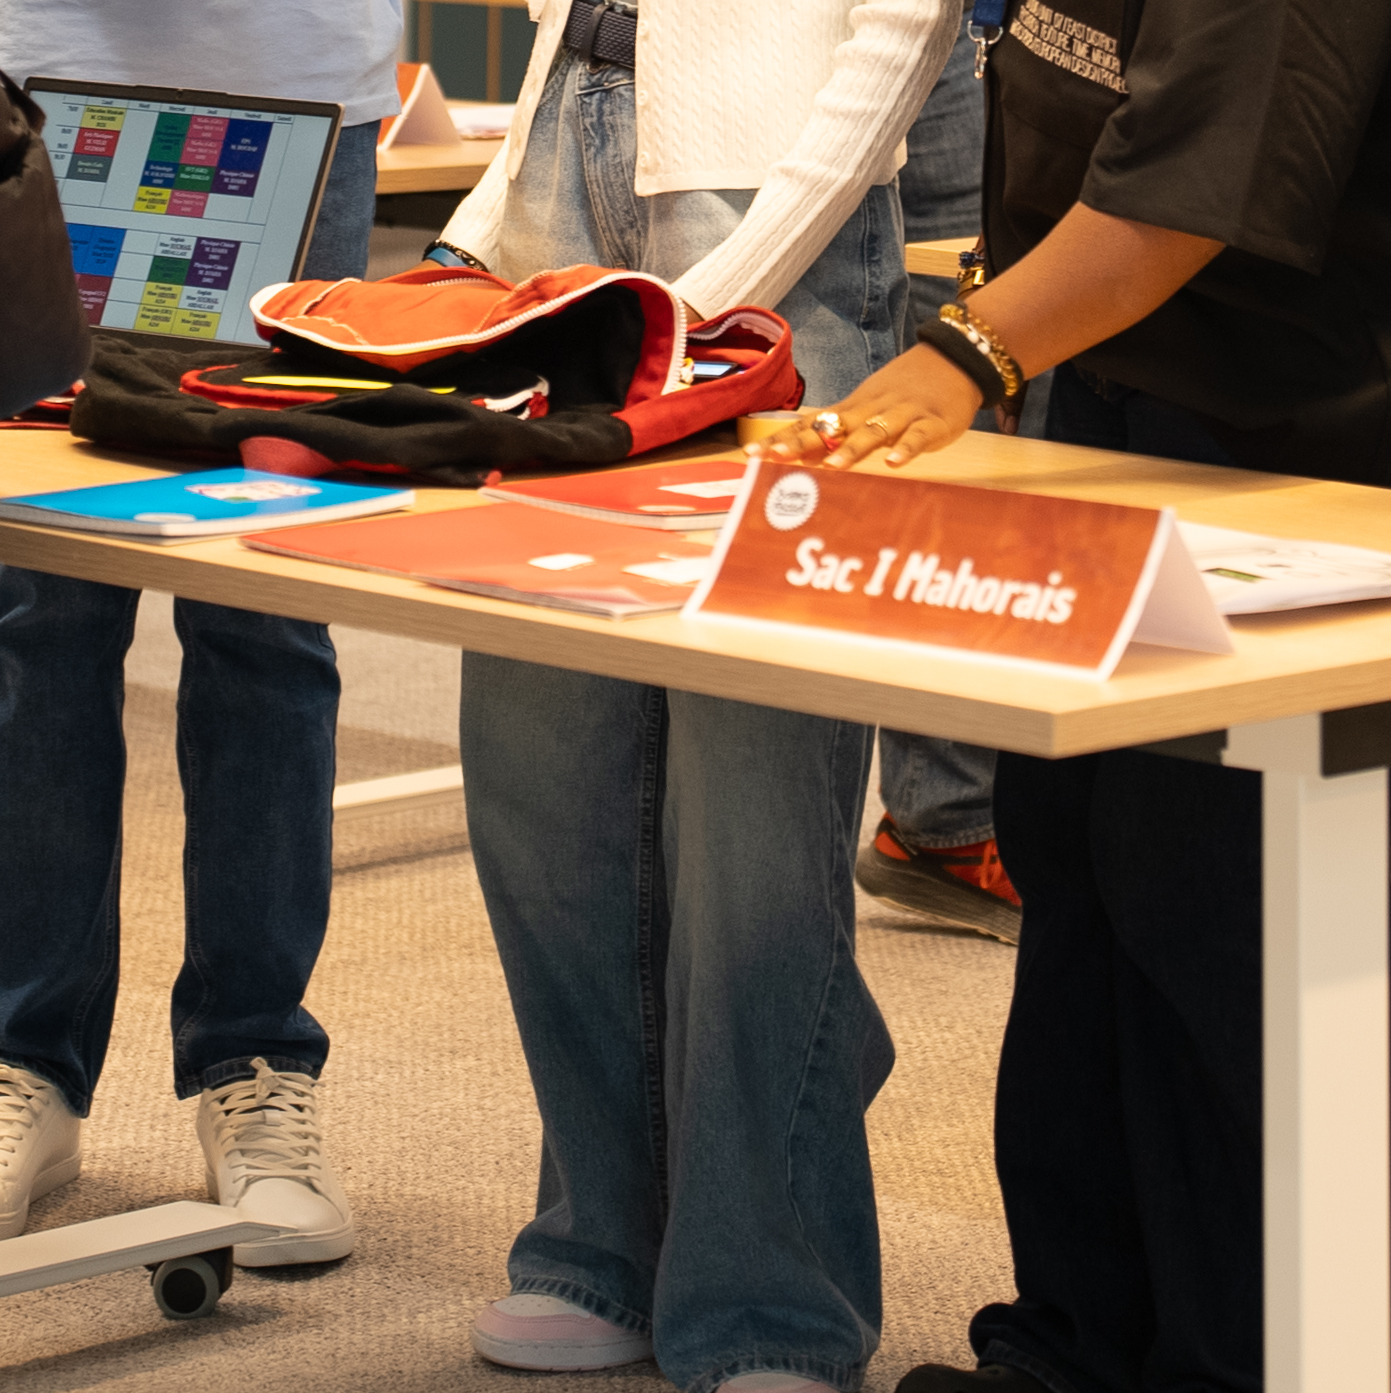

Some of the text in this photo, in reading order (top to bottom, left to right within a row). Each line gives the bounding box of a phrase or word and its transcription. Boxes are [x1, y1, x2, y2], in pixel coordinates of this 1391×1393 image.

[786, 538, 1077, 624] Sac I Mahorais
